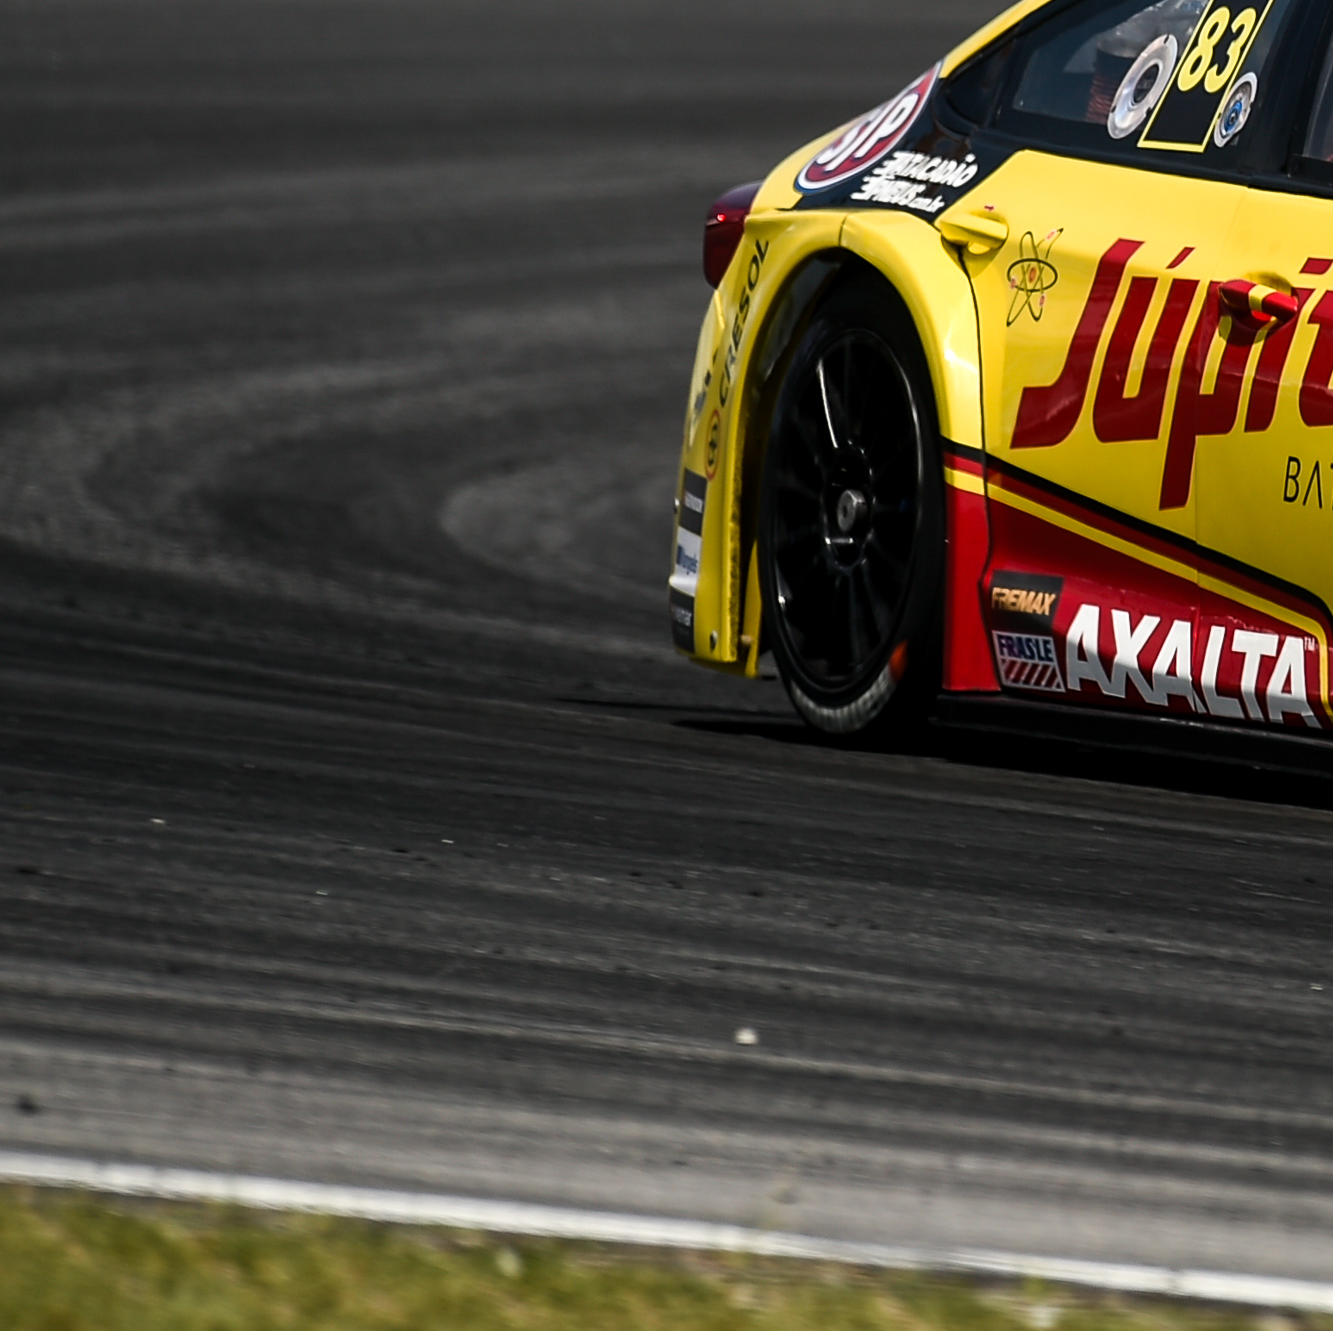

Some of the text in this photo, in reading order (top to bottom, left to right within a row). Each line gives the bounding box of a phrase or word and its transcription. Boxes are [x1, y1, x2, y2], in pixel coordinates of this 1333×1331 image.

[1177, 6, 1257, 94] 83
[991, 587, 1056, 616] FREMAX
[1065, 603, 1323, 730] AXALTA
